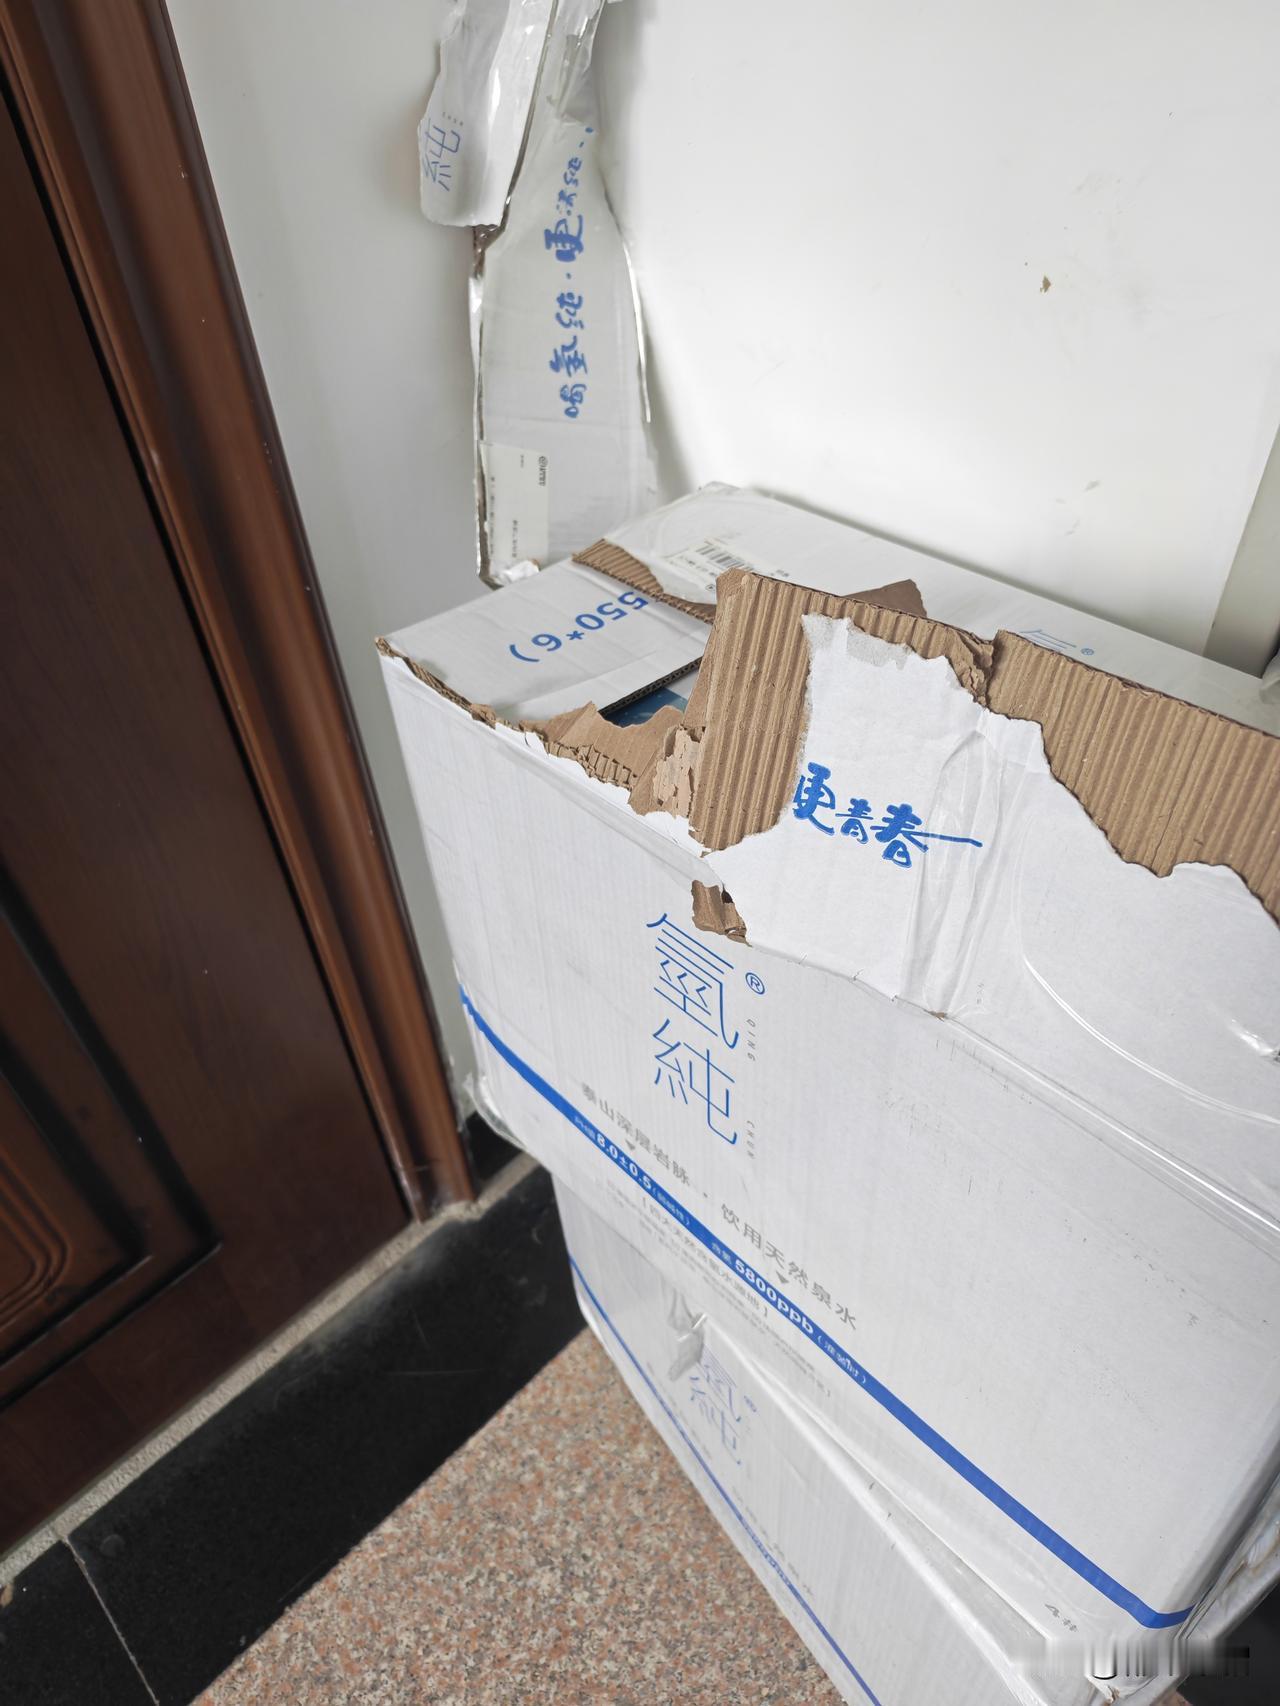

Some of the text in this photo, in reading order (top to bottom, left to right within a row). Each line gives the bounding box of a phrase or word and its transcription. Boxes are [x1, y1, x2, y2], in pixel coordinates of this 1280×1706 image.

[793, 762, 983, 868] 更青春
[735, 1259, 813, 1334] 5800ppb
